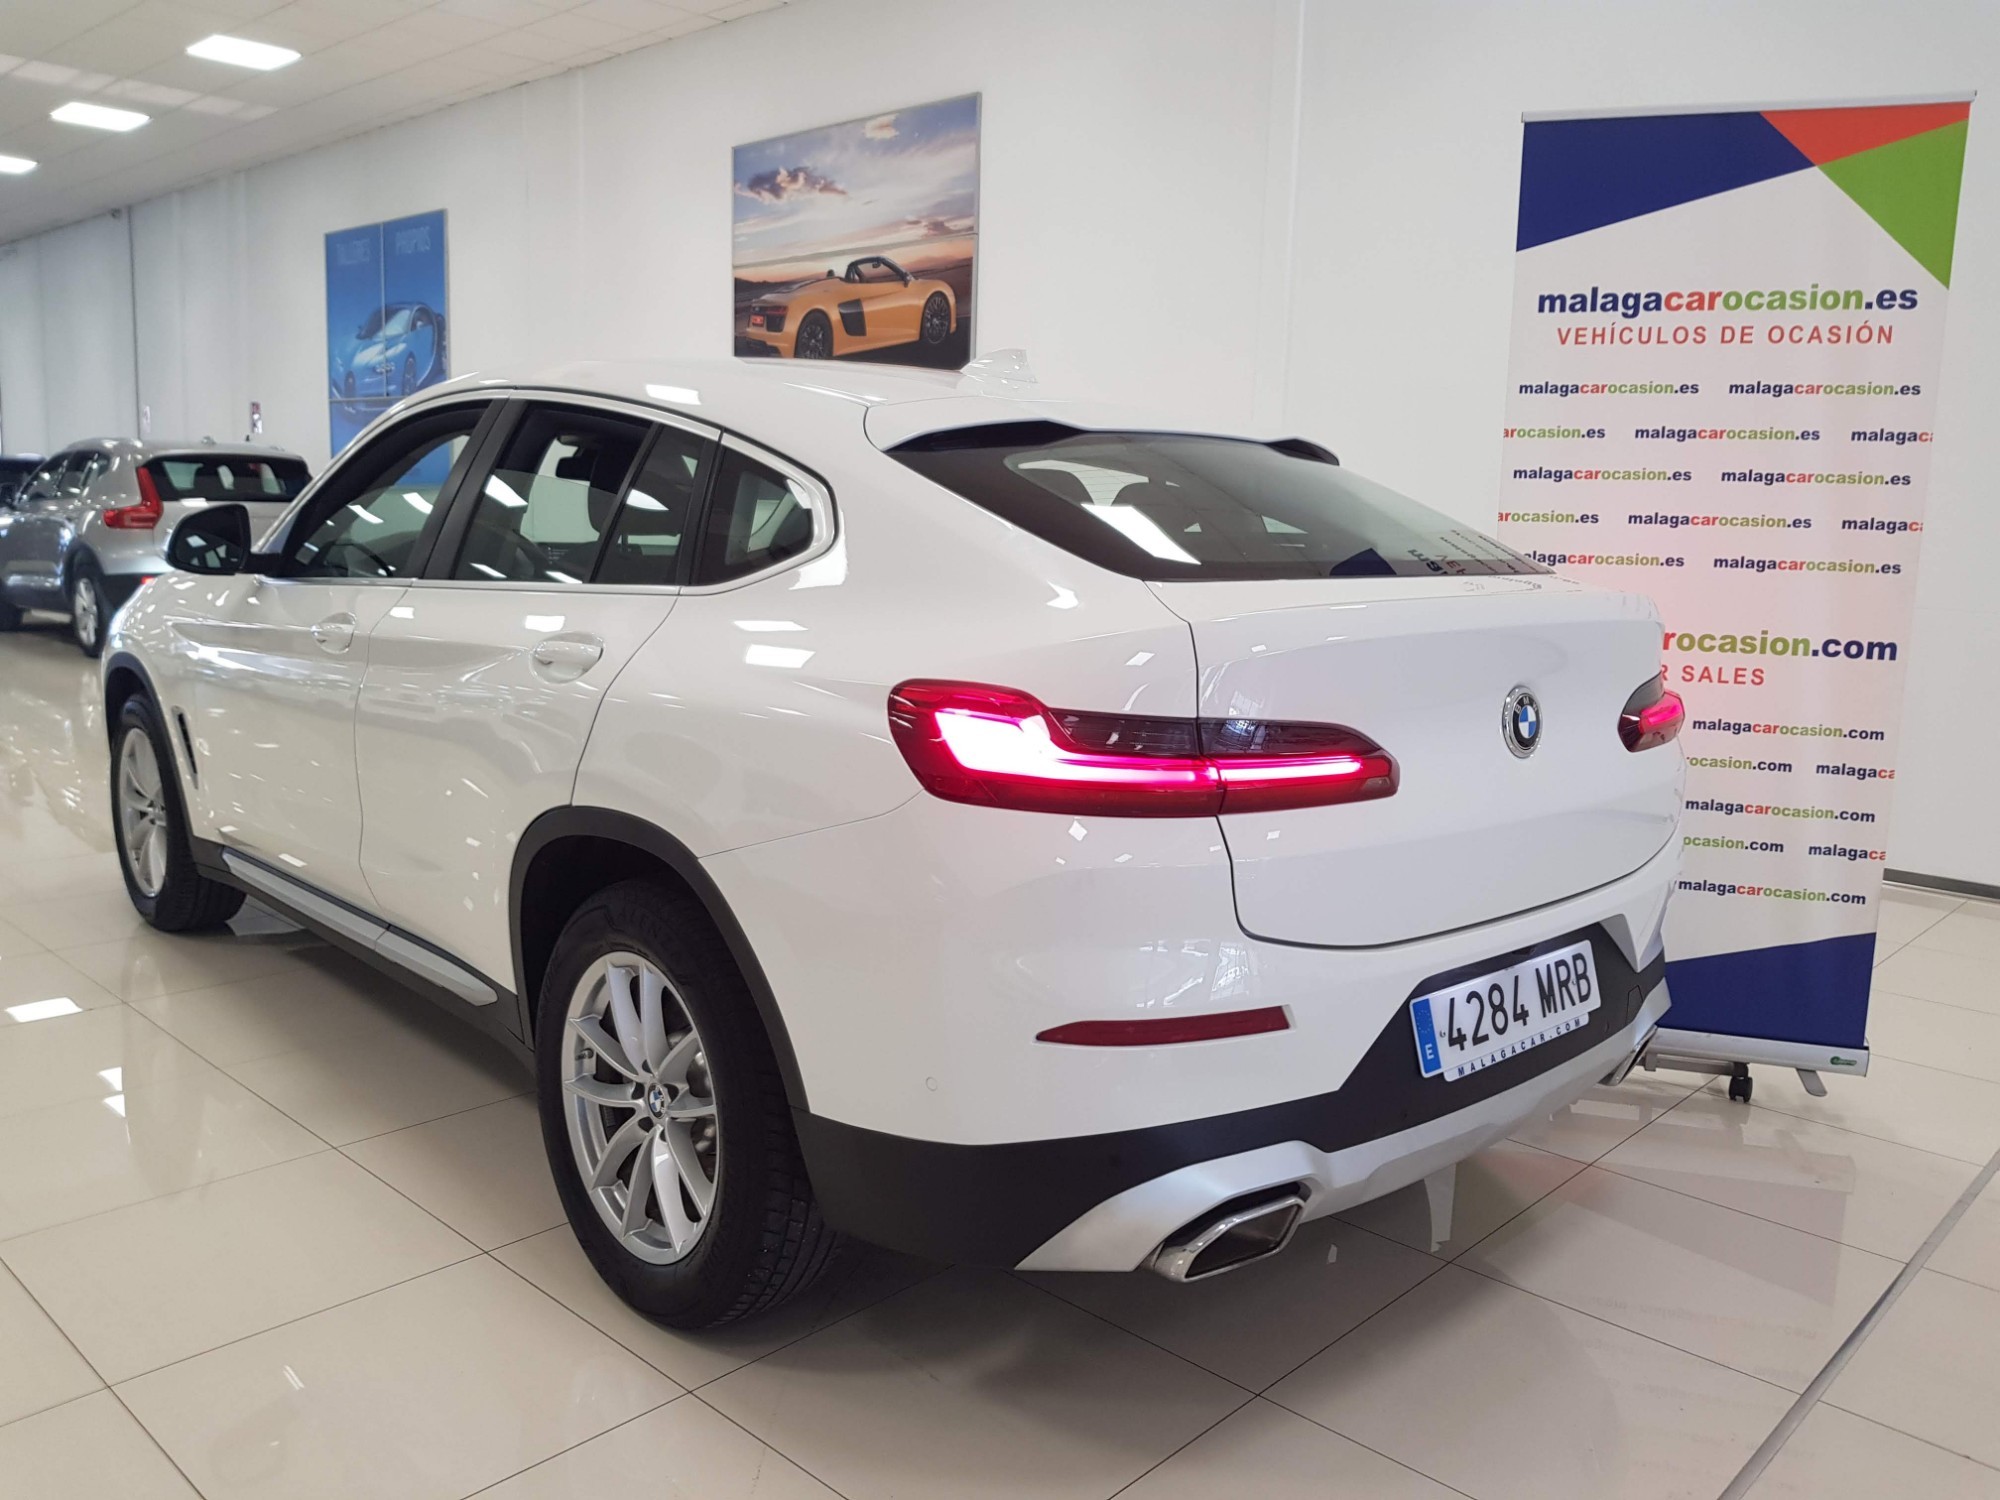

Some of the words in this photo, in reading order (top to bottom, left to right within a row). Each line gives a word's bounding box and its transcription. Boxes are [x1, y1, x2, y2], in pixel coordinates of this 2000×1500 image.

[1537, 283, 1918, 319] malagacarocasion.es
[1557, 322, 1707, 345] VEHÍCULOS
[1720, 325, 1754, 344] DE
[1767, 320, 1893, 344] OCASIÓN
[1519, 381, 1699, 397] malagacarocasion.es
[1728, 381, 1921, 397] malagacarocasion.es
[1635, 426, 1820, 442] malagacarocasion.es
[1513, 466, 1692, 482] malagacarocasion.es
[1721, 469, 1911, 486] malagacarocasion.es
[1628, 512, 1812, 528] malagacarocasion.es
[1713, 556, 1901, 574] malagacarocasion.es
[1681, 665, 1765, 686] SALES
[1514, 696, 1538, 714] BMW
[1692, 719, 1885, 741] malagacarocasion.com
[1687, 756, 1792, 773] ocasion.com
[1685, 799, 1875, 823] malagacarocasion.com
[1683, 835, 1784, 853] ocasion.com
[1678, 880, 1866, 905] malagacarocasion.com
[1447, 974, 1529, 1052] 4284
[1535, 952, 1592, 1019] MRB
[1425, 1043, 1435, 1060] E
[1458, 1018, 1581, 1076] MALAGACAR.COM
